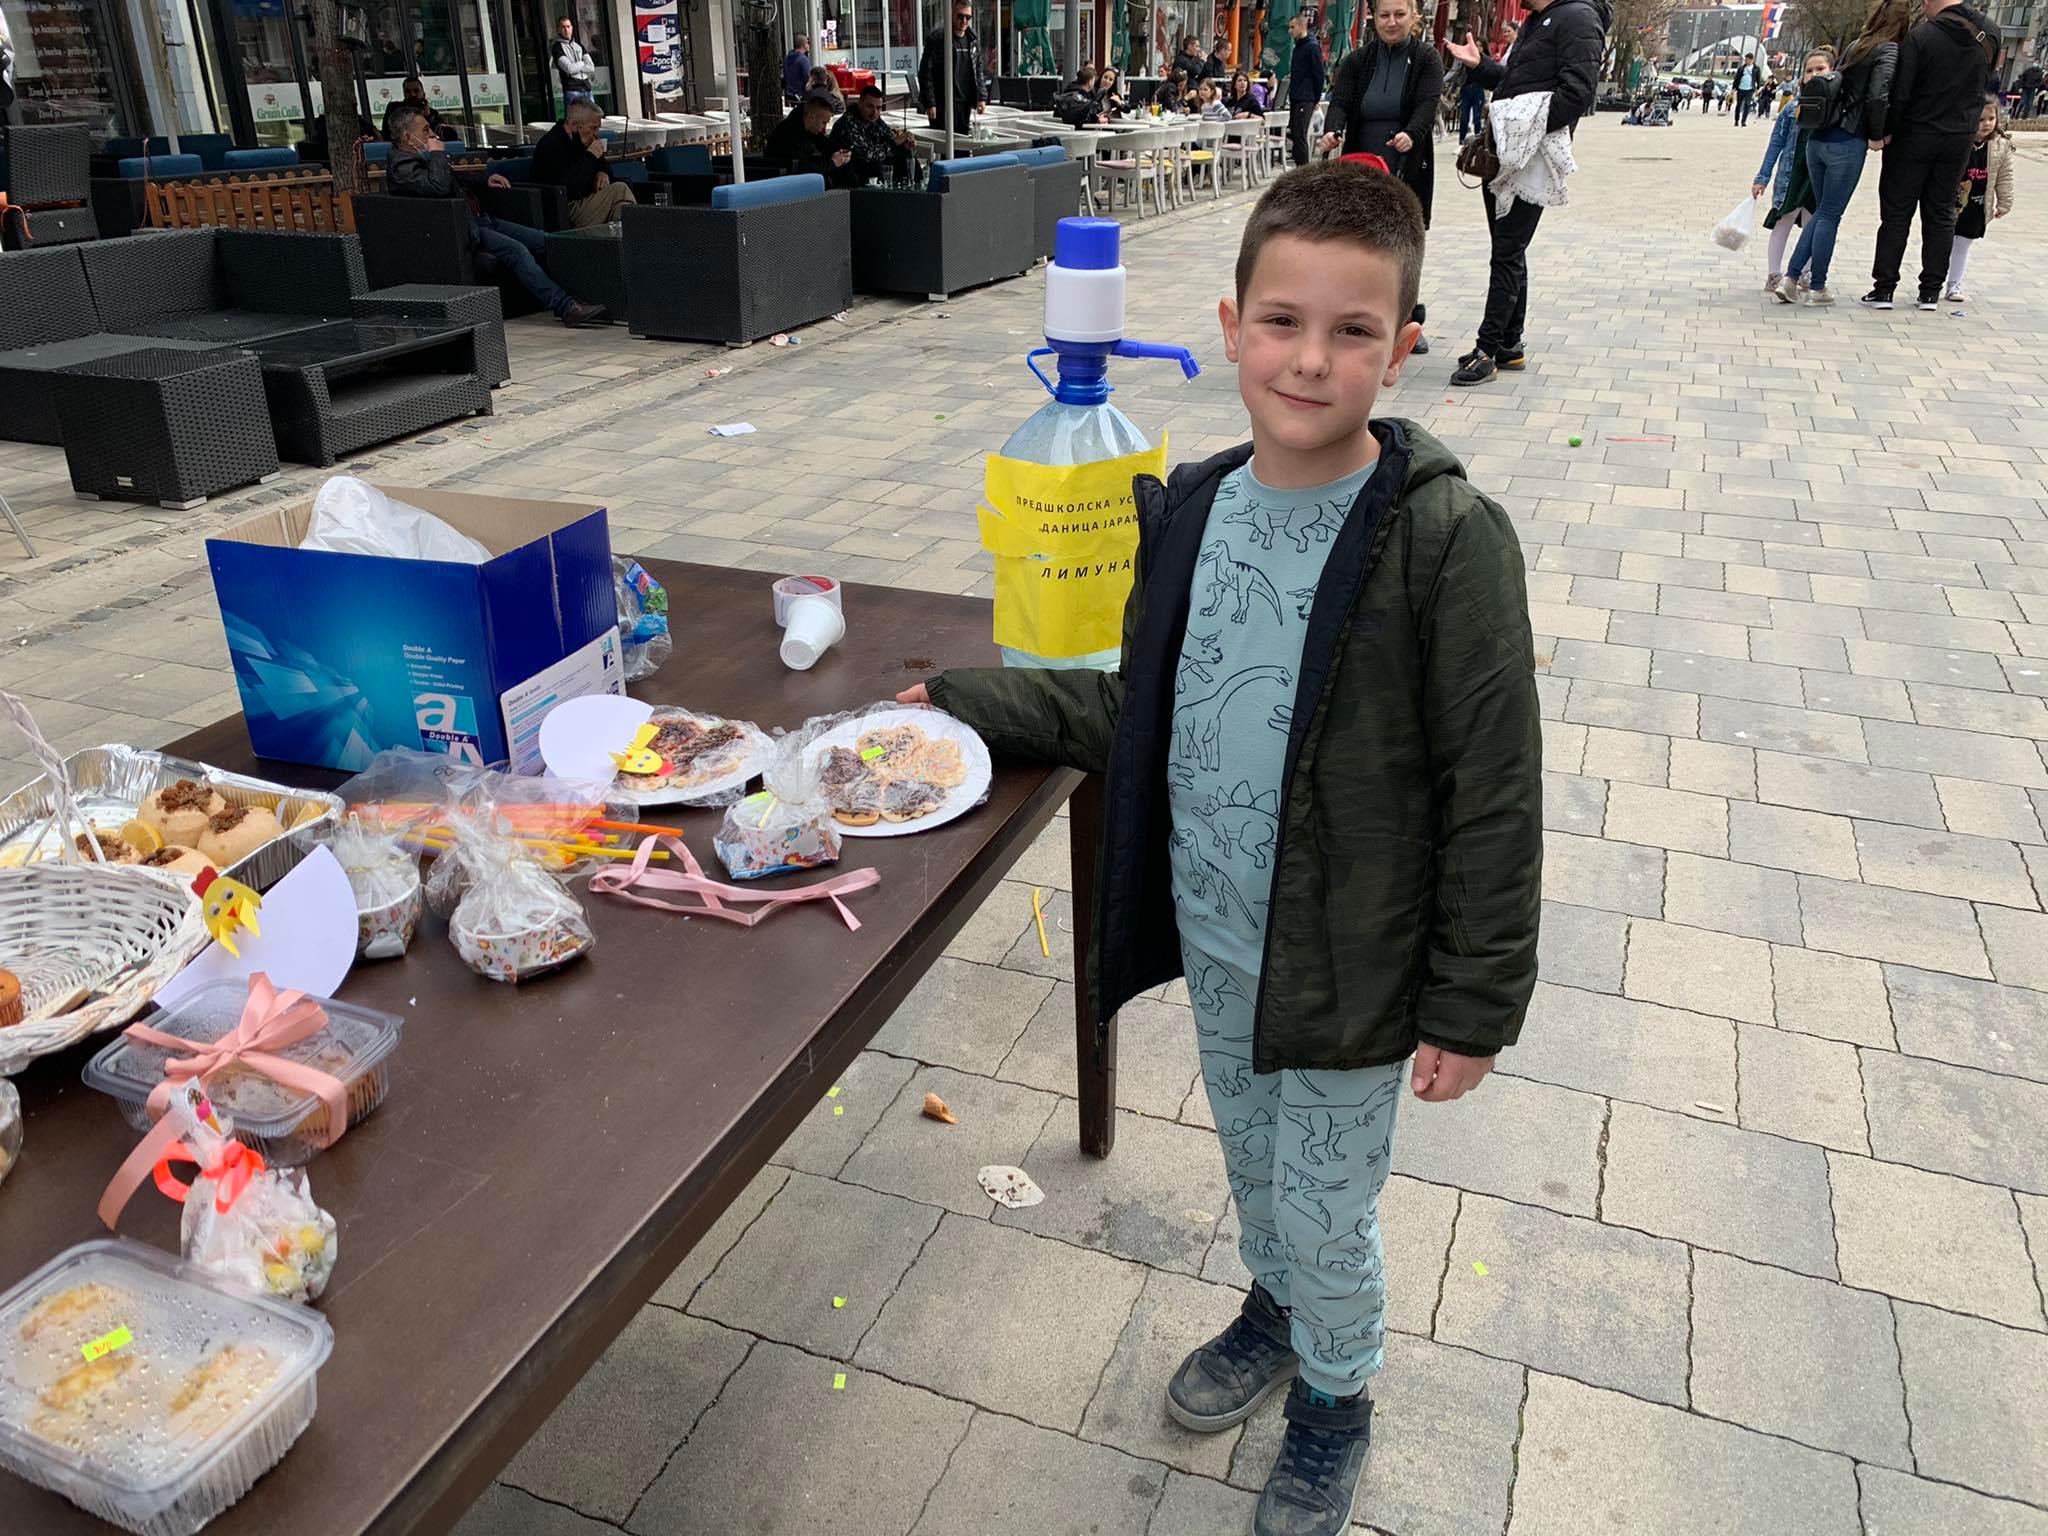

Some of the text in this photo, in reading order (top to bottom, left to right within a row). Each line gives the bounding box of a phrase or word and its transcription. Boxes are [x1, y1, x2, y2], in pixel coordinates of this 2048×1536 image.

[257, 107, 280, 119] Green
[1016, 495, 1112, 513] ПРЕДШКОЛСКА
[1041, 558, 1131, 579] ЛИМУНА
[403, 644, 425, 653] Double
[404, 652, 466, 665] Double Quality Paper
[429, 732, 469, 743] Double A
